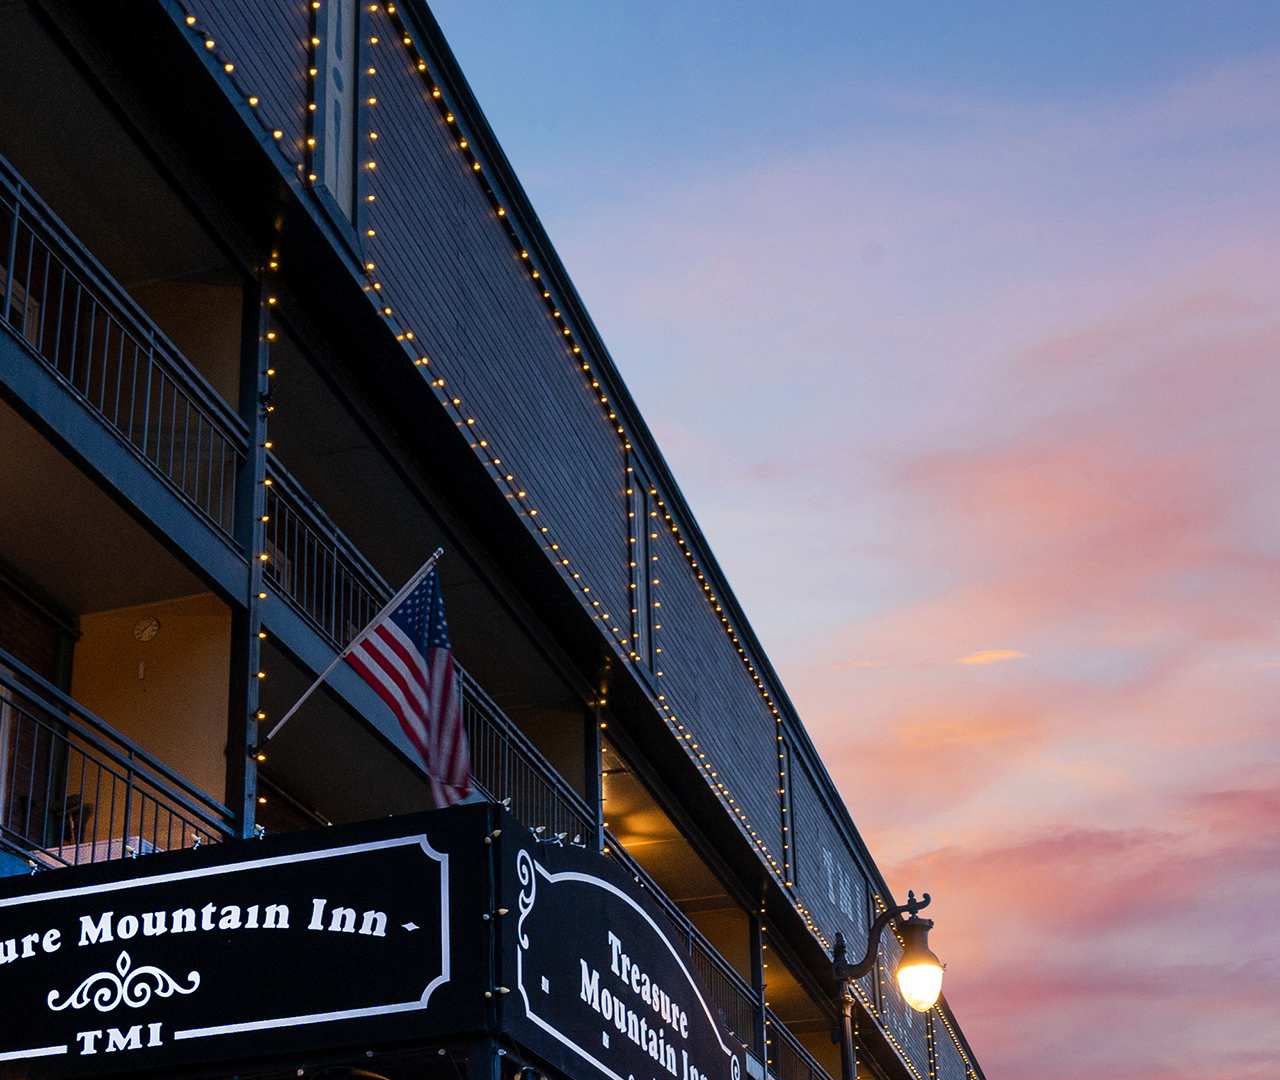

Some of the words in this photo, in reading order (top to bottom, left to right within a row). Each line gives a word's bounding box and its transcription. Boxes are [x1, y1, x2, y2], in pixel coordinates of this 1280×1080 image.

[77, 902, 290, 947] Mountain
[307, 898, 388, 937] Inn
[579, 958, 678, 1077] Mountain
[607, 930, 689, 1039] Treasure
[76, 1022, 164, 1056] TMI
